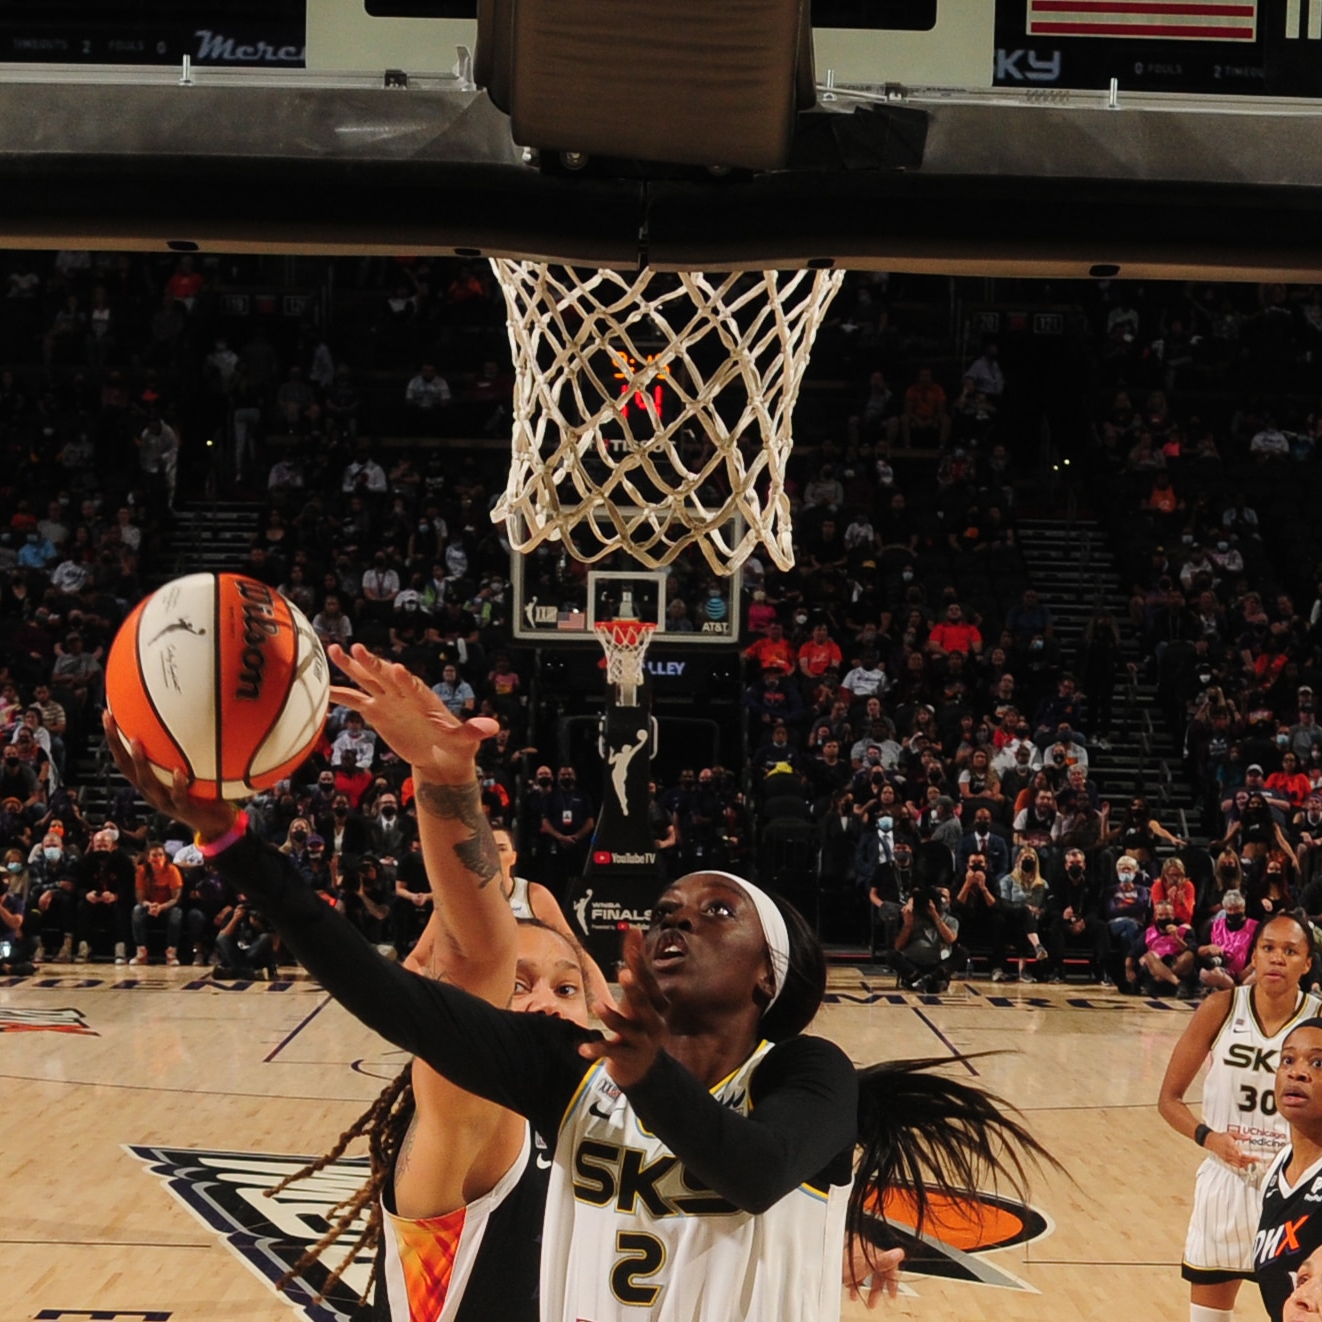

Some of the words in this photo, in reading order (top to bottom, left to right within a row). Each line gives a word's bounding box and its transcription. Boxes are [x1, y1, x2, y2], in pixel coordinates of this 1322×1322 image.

[193, 28, 305, 61] Merc
[995, 48, 1062, 82] KY
[702, 621, 729, 633] AT&T
[591, 909, 652, 921] FINALS
[1238, 1083, 1278, 1116] 30
[1243, 1127, 1287, 1139] UChicago
[609, 1230, 667, 1308] 2
